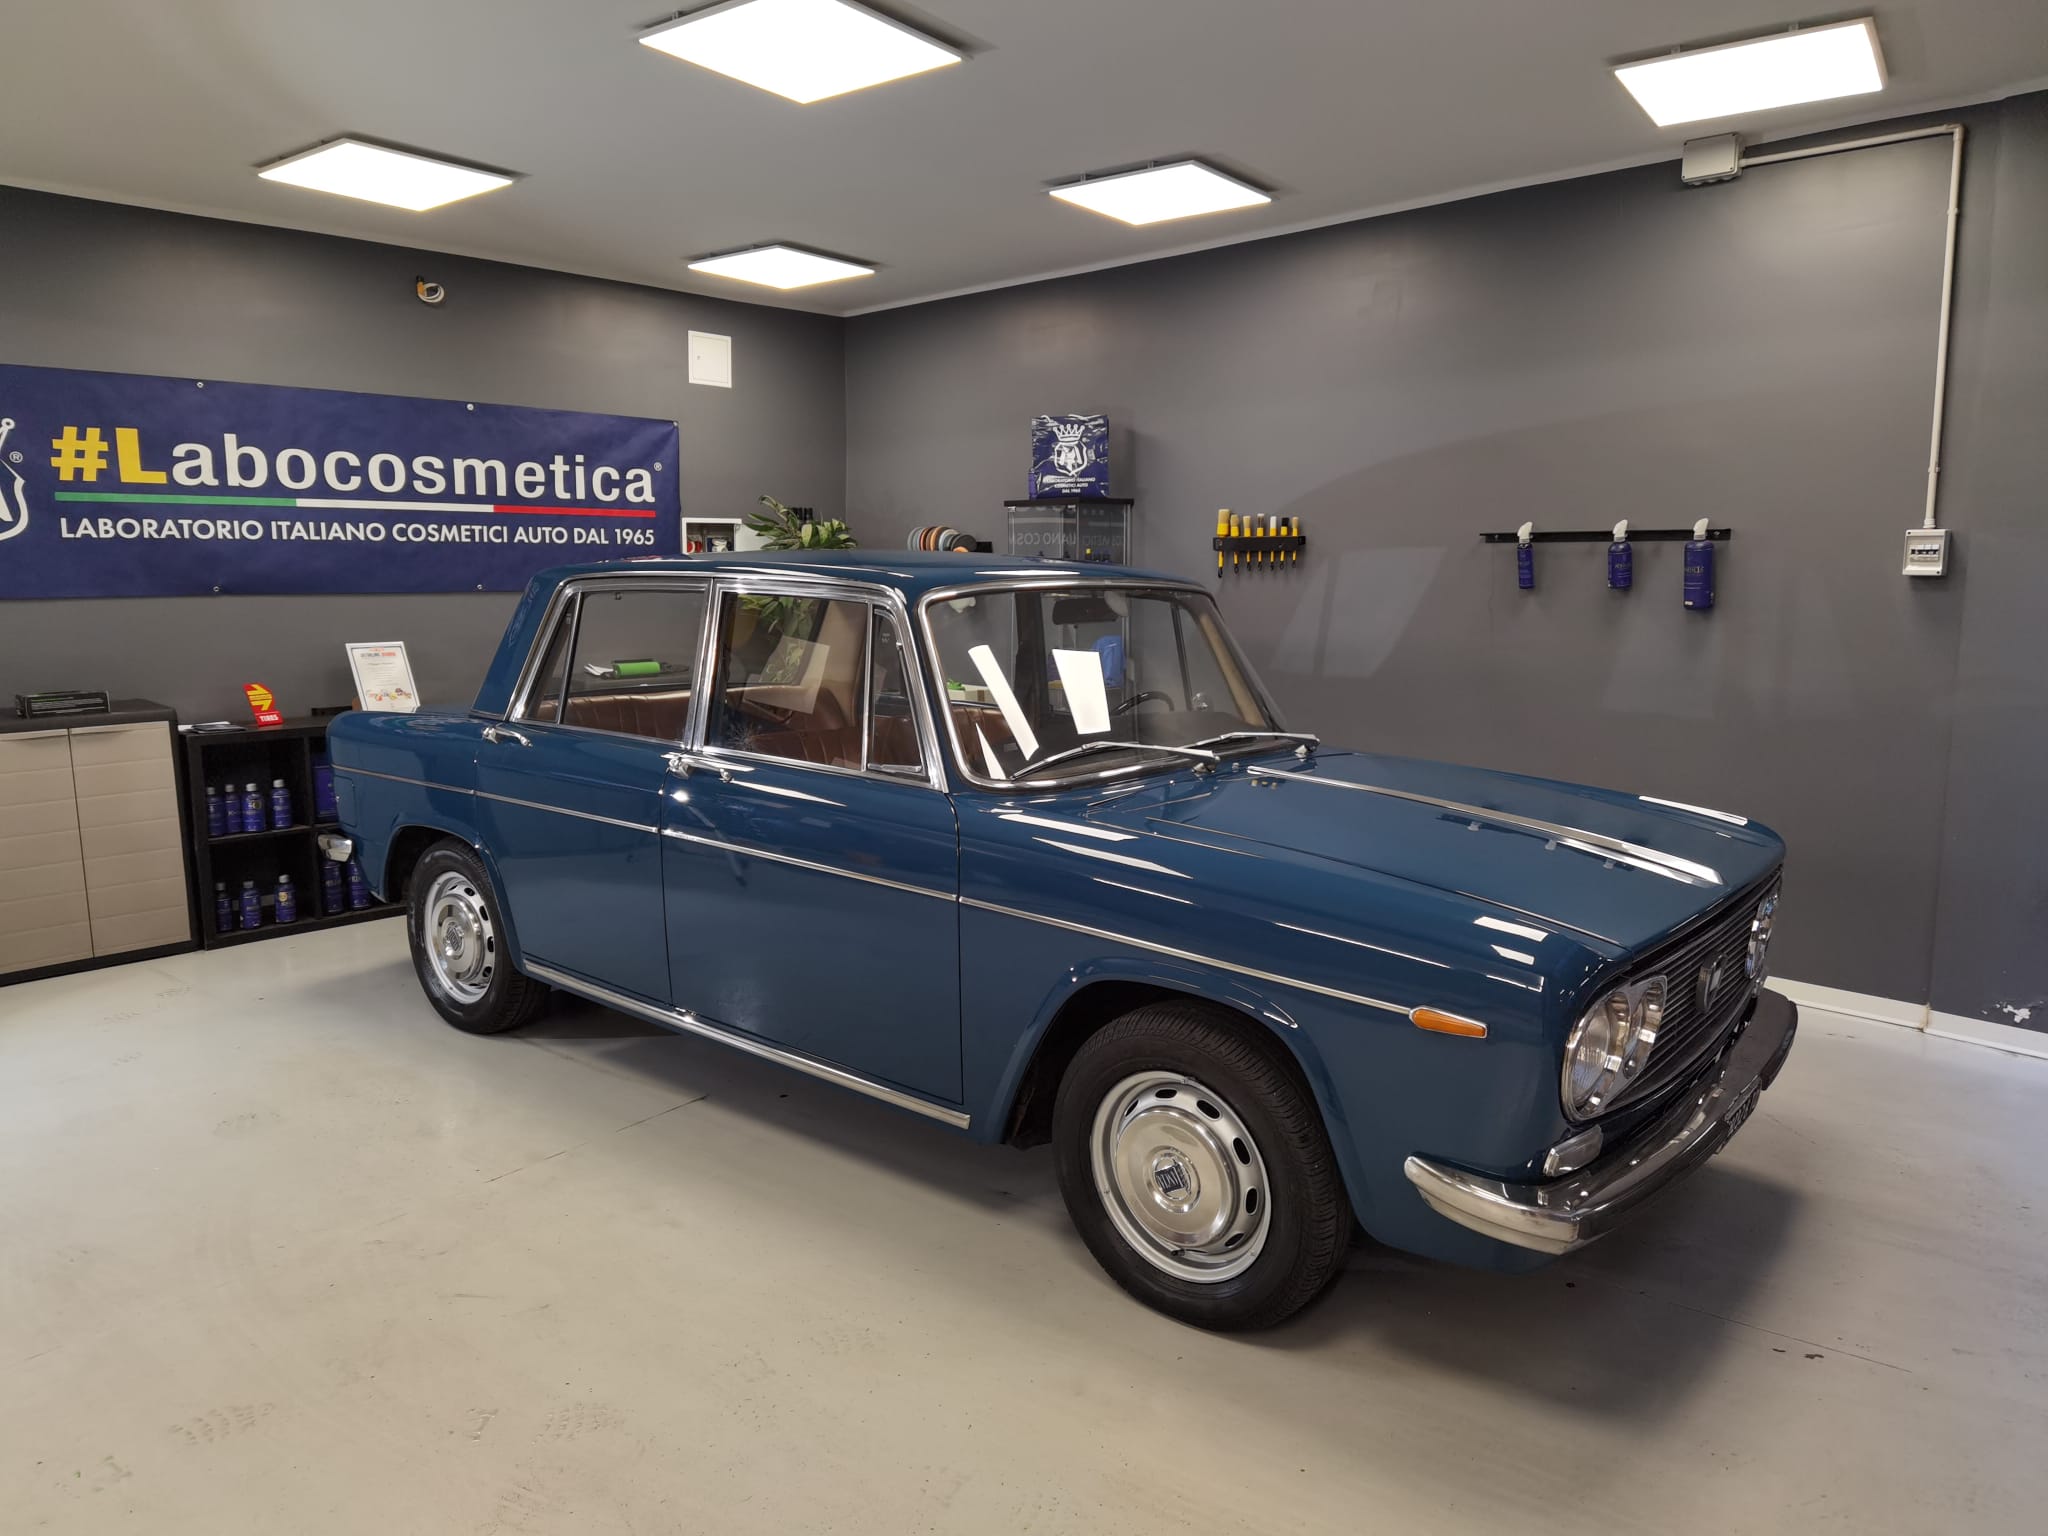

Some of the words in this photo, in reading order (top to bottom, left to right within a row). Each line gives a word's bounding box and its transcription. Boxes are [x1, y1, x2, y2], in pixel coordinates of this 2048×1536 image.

[60, 517, 263, 540] LABORATORIO
[271, 520, 386, 542] ITALIANO
[392, 523, 508, 543] COSMETICI
[514, 526, 568, 544] AUTO
[573, 527, 609, 544] DAL
[615, 528, 655, 545] 1965
